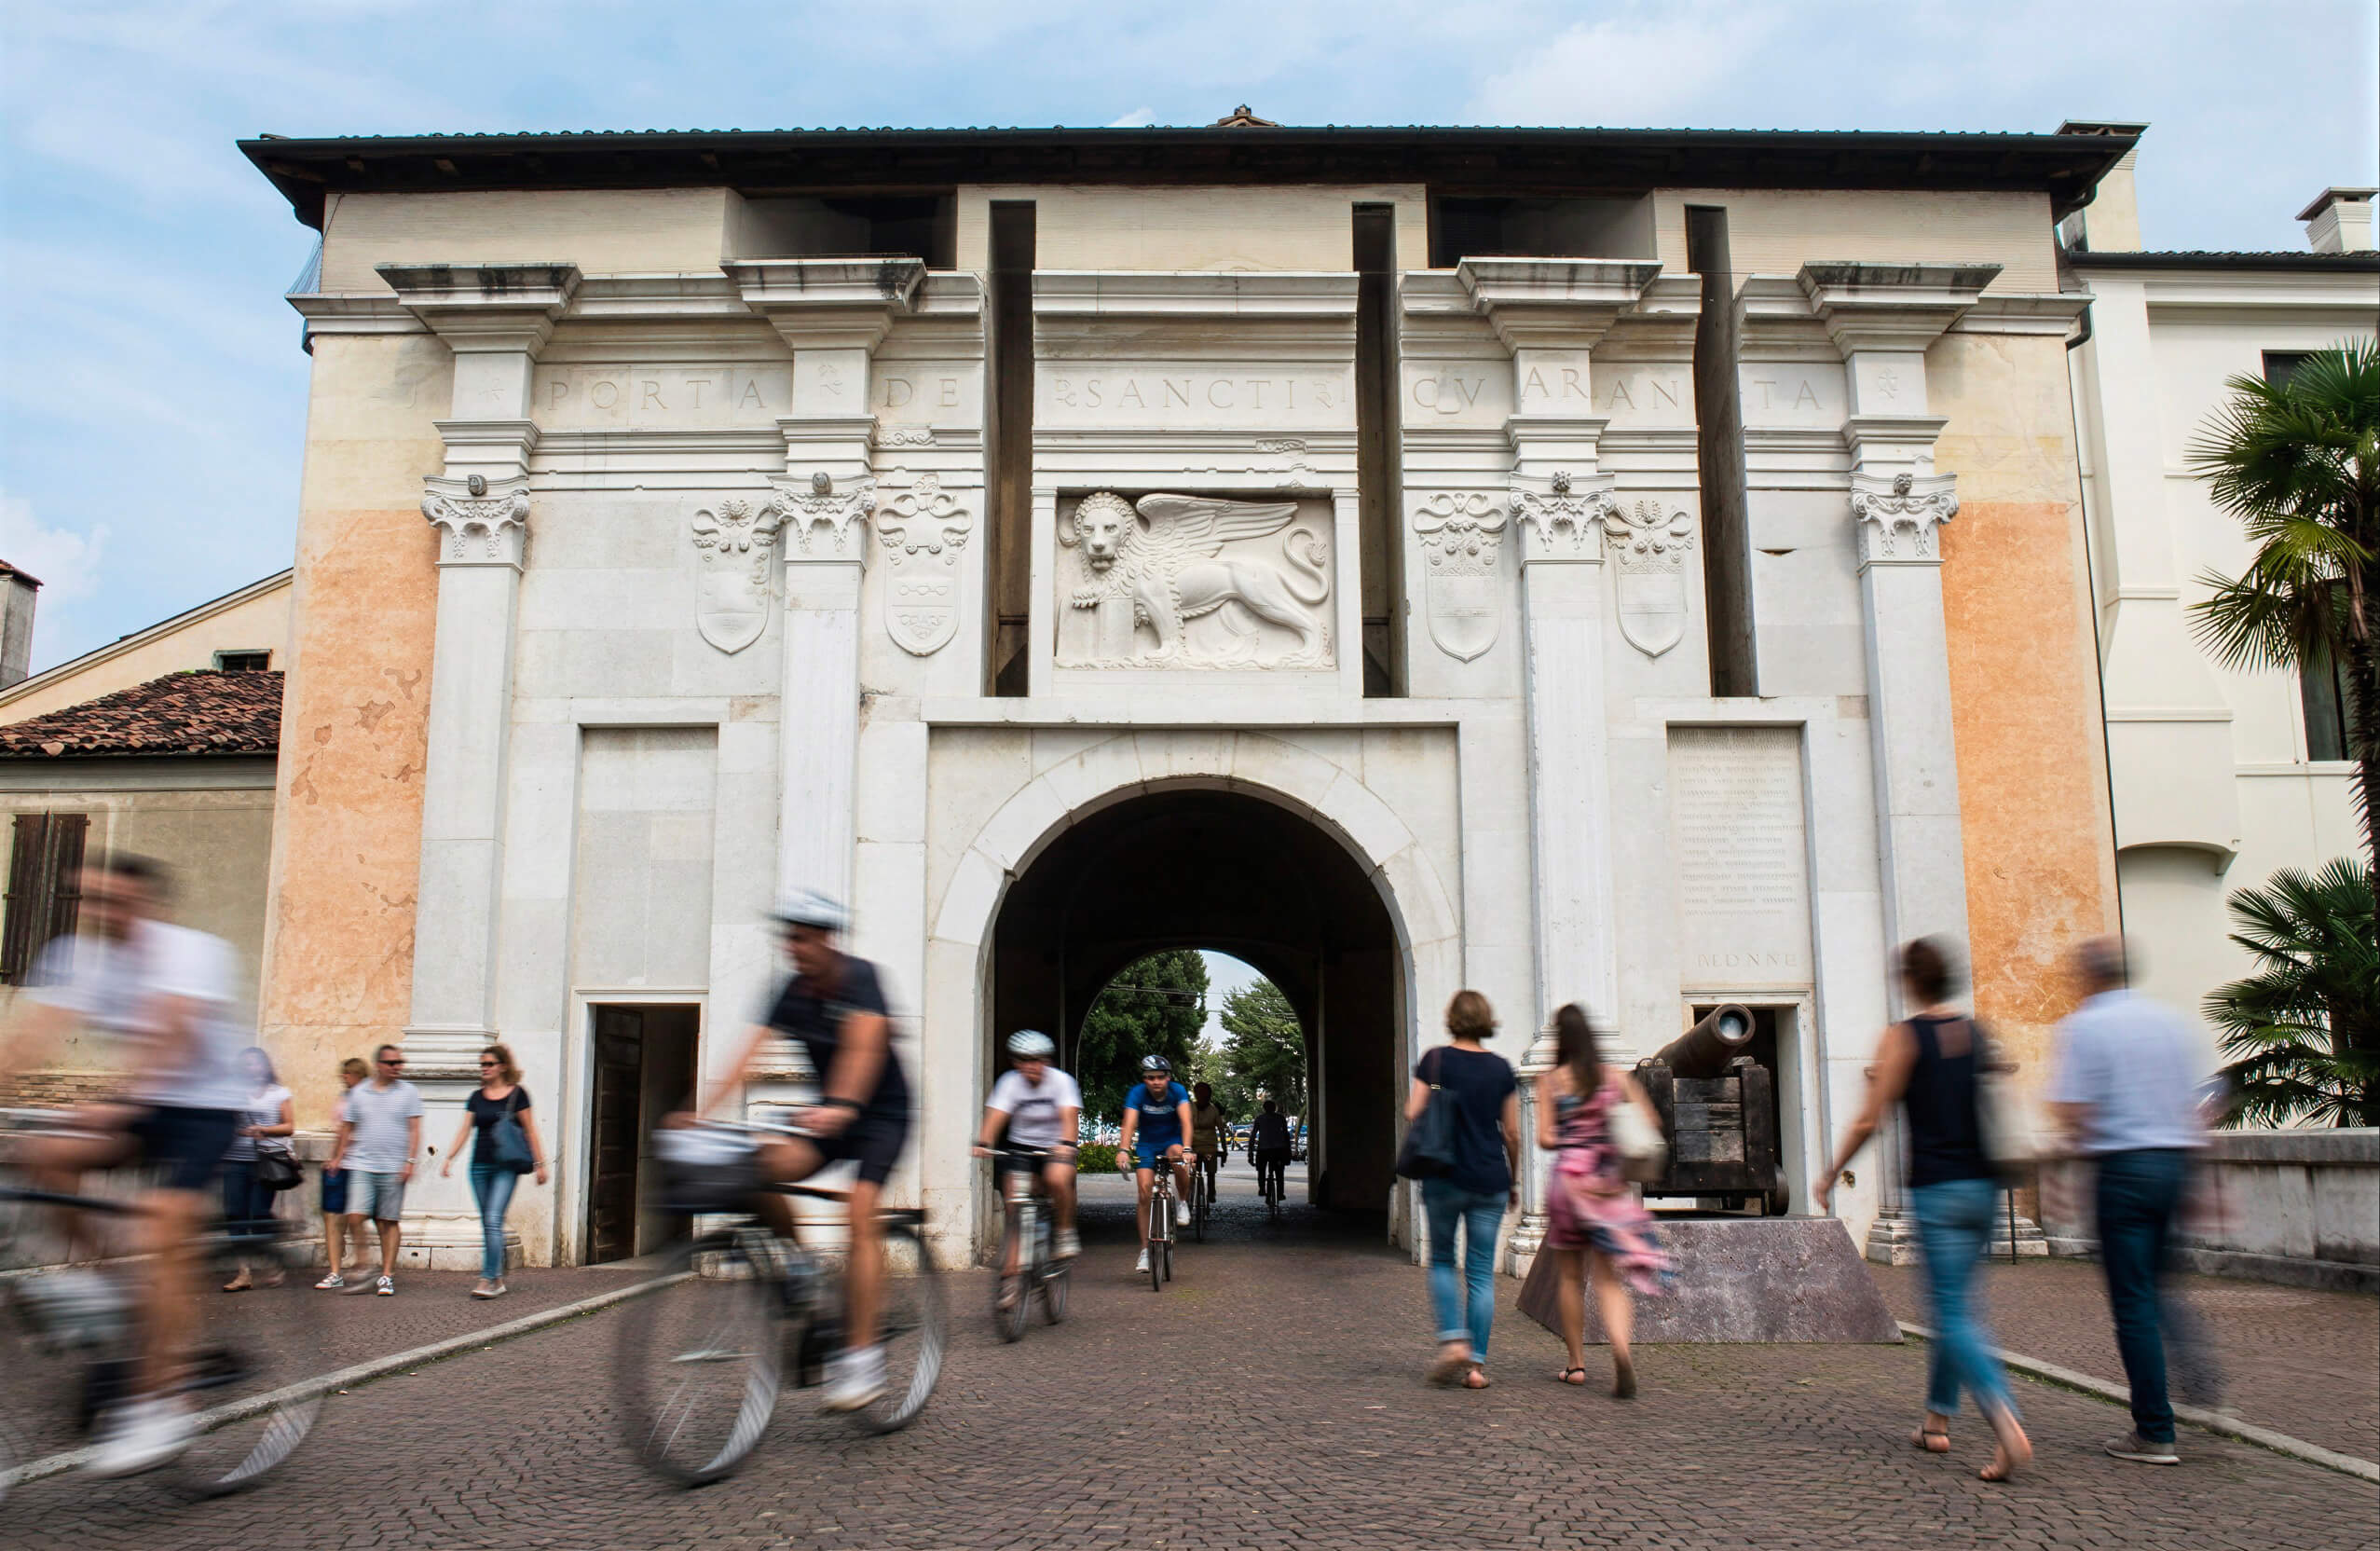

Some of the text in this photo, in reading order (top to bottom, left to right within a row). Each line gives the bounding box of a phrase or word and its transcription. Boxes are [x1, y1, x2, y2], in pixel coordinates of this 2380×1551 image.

[548, 378, 769, 412] PORTA
[883, 377, 960, 408] DE
[1085, 377, 1296, 410] SANCTI
